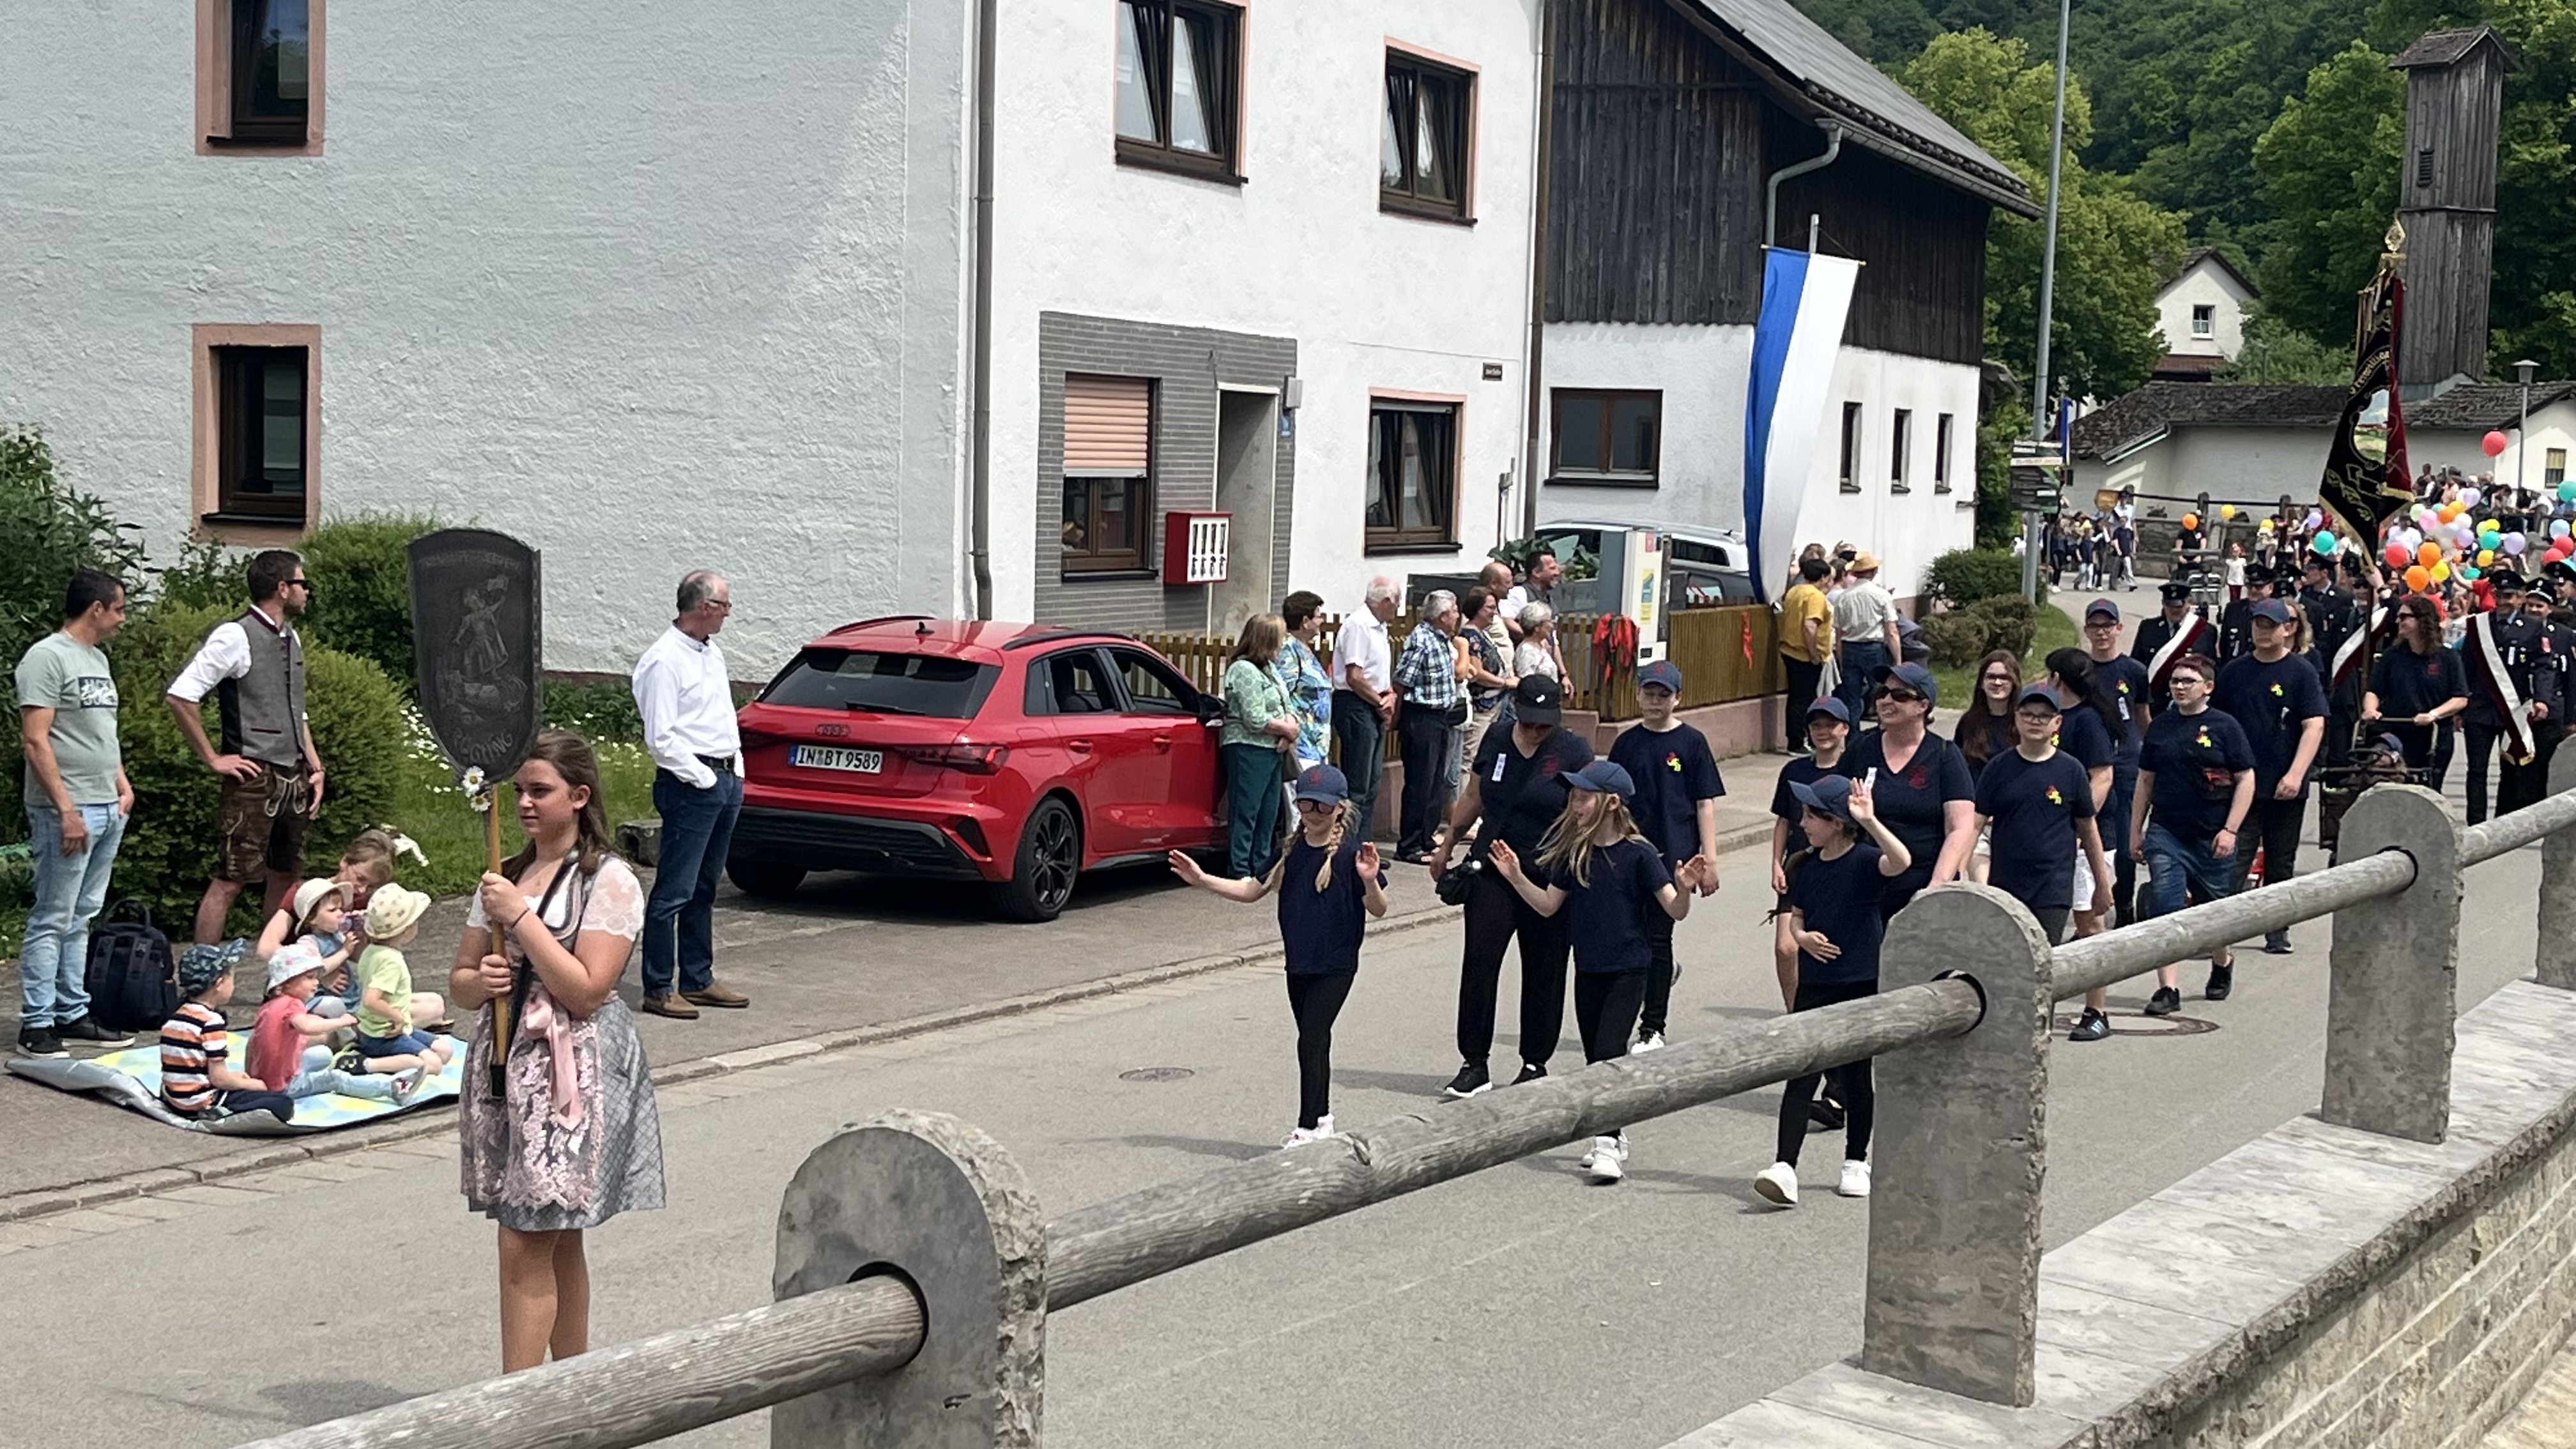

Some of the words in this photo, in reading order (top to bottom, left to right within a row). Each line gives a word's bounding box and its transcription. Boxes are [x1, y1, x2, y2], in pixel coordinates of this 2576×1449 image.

[798, 747, 816, 765] IN
[824, 749, 843, 767] BT
[845, 751, 880, 770] 9589
